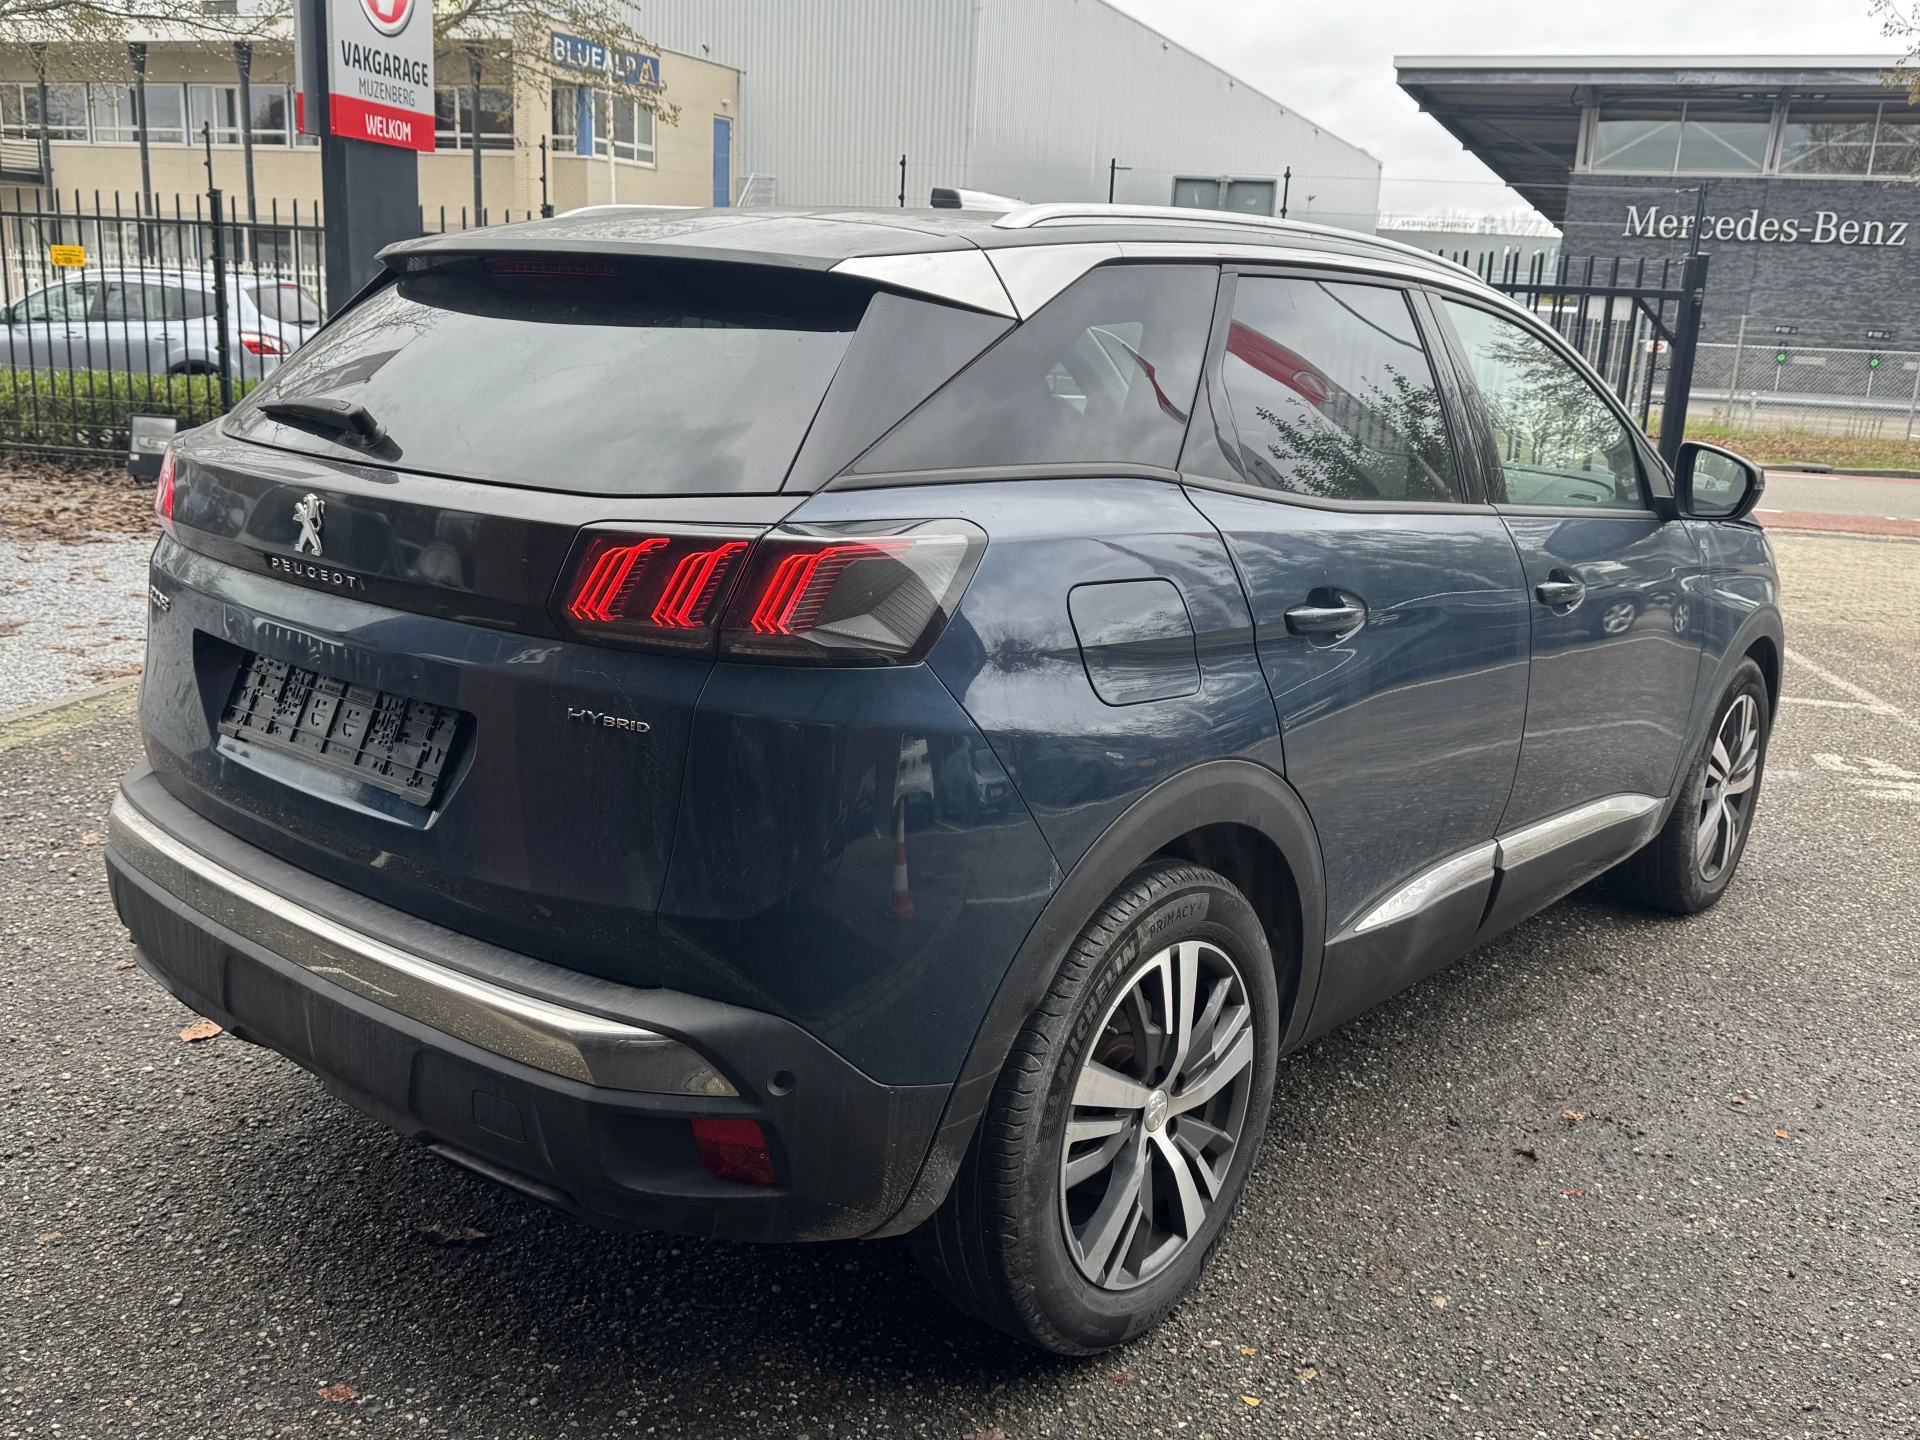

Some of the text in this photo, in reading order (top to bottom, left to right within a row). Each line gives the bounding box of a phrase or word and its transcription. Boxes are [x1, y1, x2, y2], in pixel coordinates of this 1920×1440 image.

[341, 39, 429, 88] VAKGARAGE
[358, 77, 416, 108] MUZENBERG
[364, 113, 412, 143] WELKOM
[1622, 205, 1909, 246] Mercedes-Benz
[271, 557, 356, 588] PEUGEOT
[567, 707, 651, 733] HYBRID
[1058, 941, 1136, 1084] MICHELIN
[1149, 902, 1196, 939] PRIMACY
